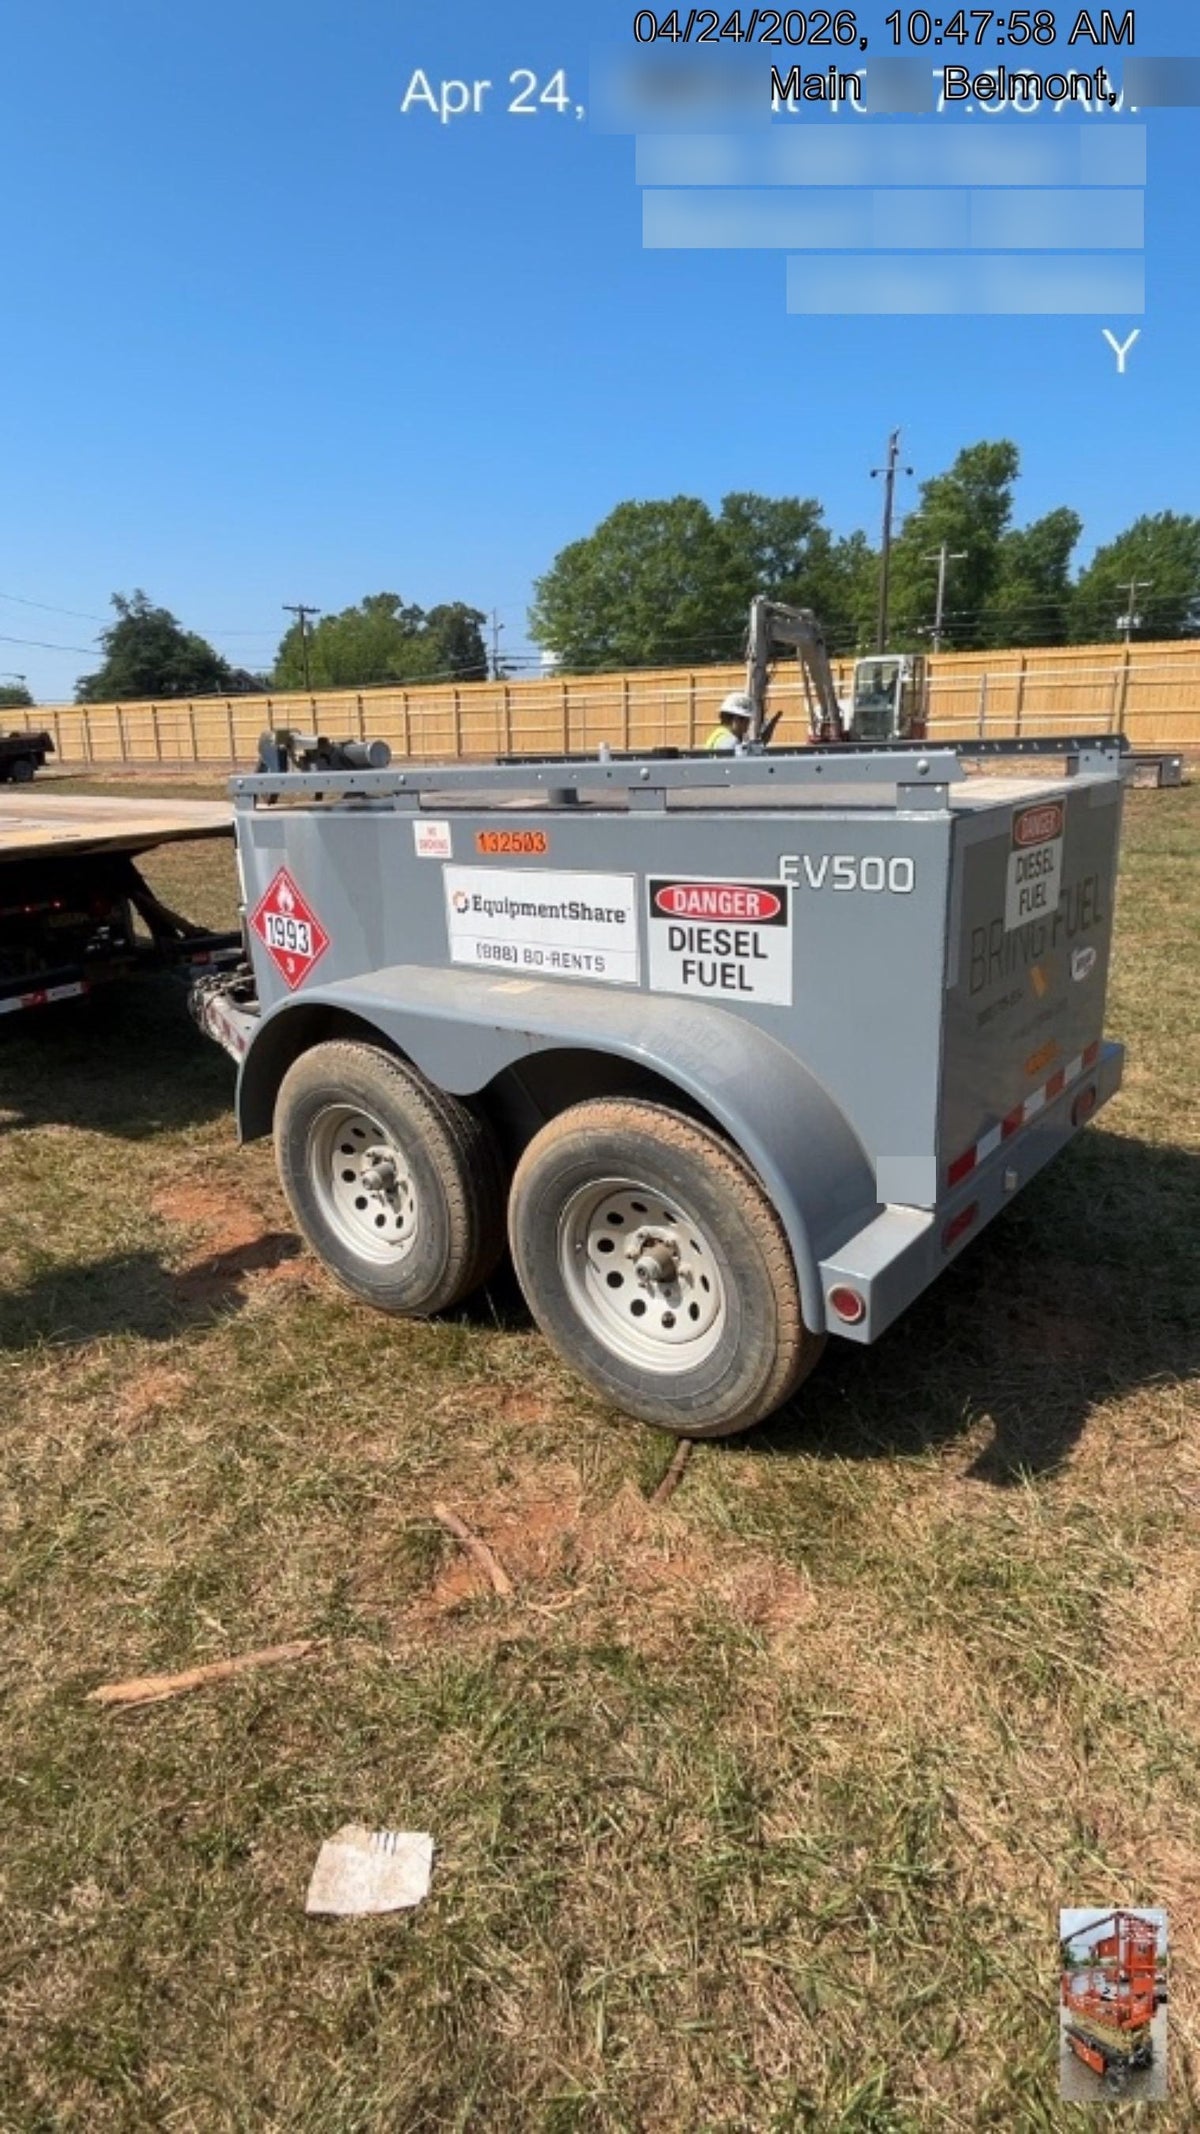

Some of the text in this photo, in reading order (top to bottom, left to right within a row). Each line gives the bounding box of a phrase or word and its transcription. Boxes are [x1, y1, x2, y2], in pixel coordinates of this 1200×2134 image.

[478, 831, 546, 853] 132503
[779, 854, 916, 894] EV500
[1016, 846, 1055, 884] DIESEL
[471, 893, 627, 924] EquipmentShare
[671, 888, 761, 917] DANGER
[1019, 881, 1048, 916] FUEL
[267, 916, 309, 954] 1993
[667, 925, 769, 960] DIESEL
[475, 942, 518, 964] (888)
[681, 958, 754, 992] FUEL
